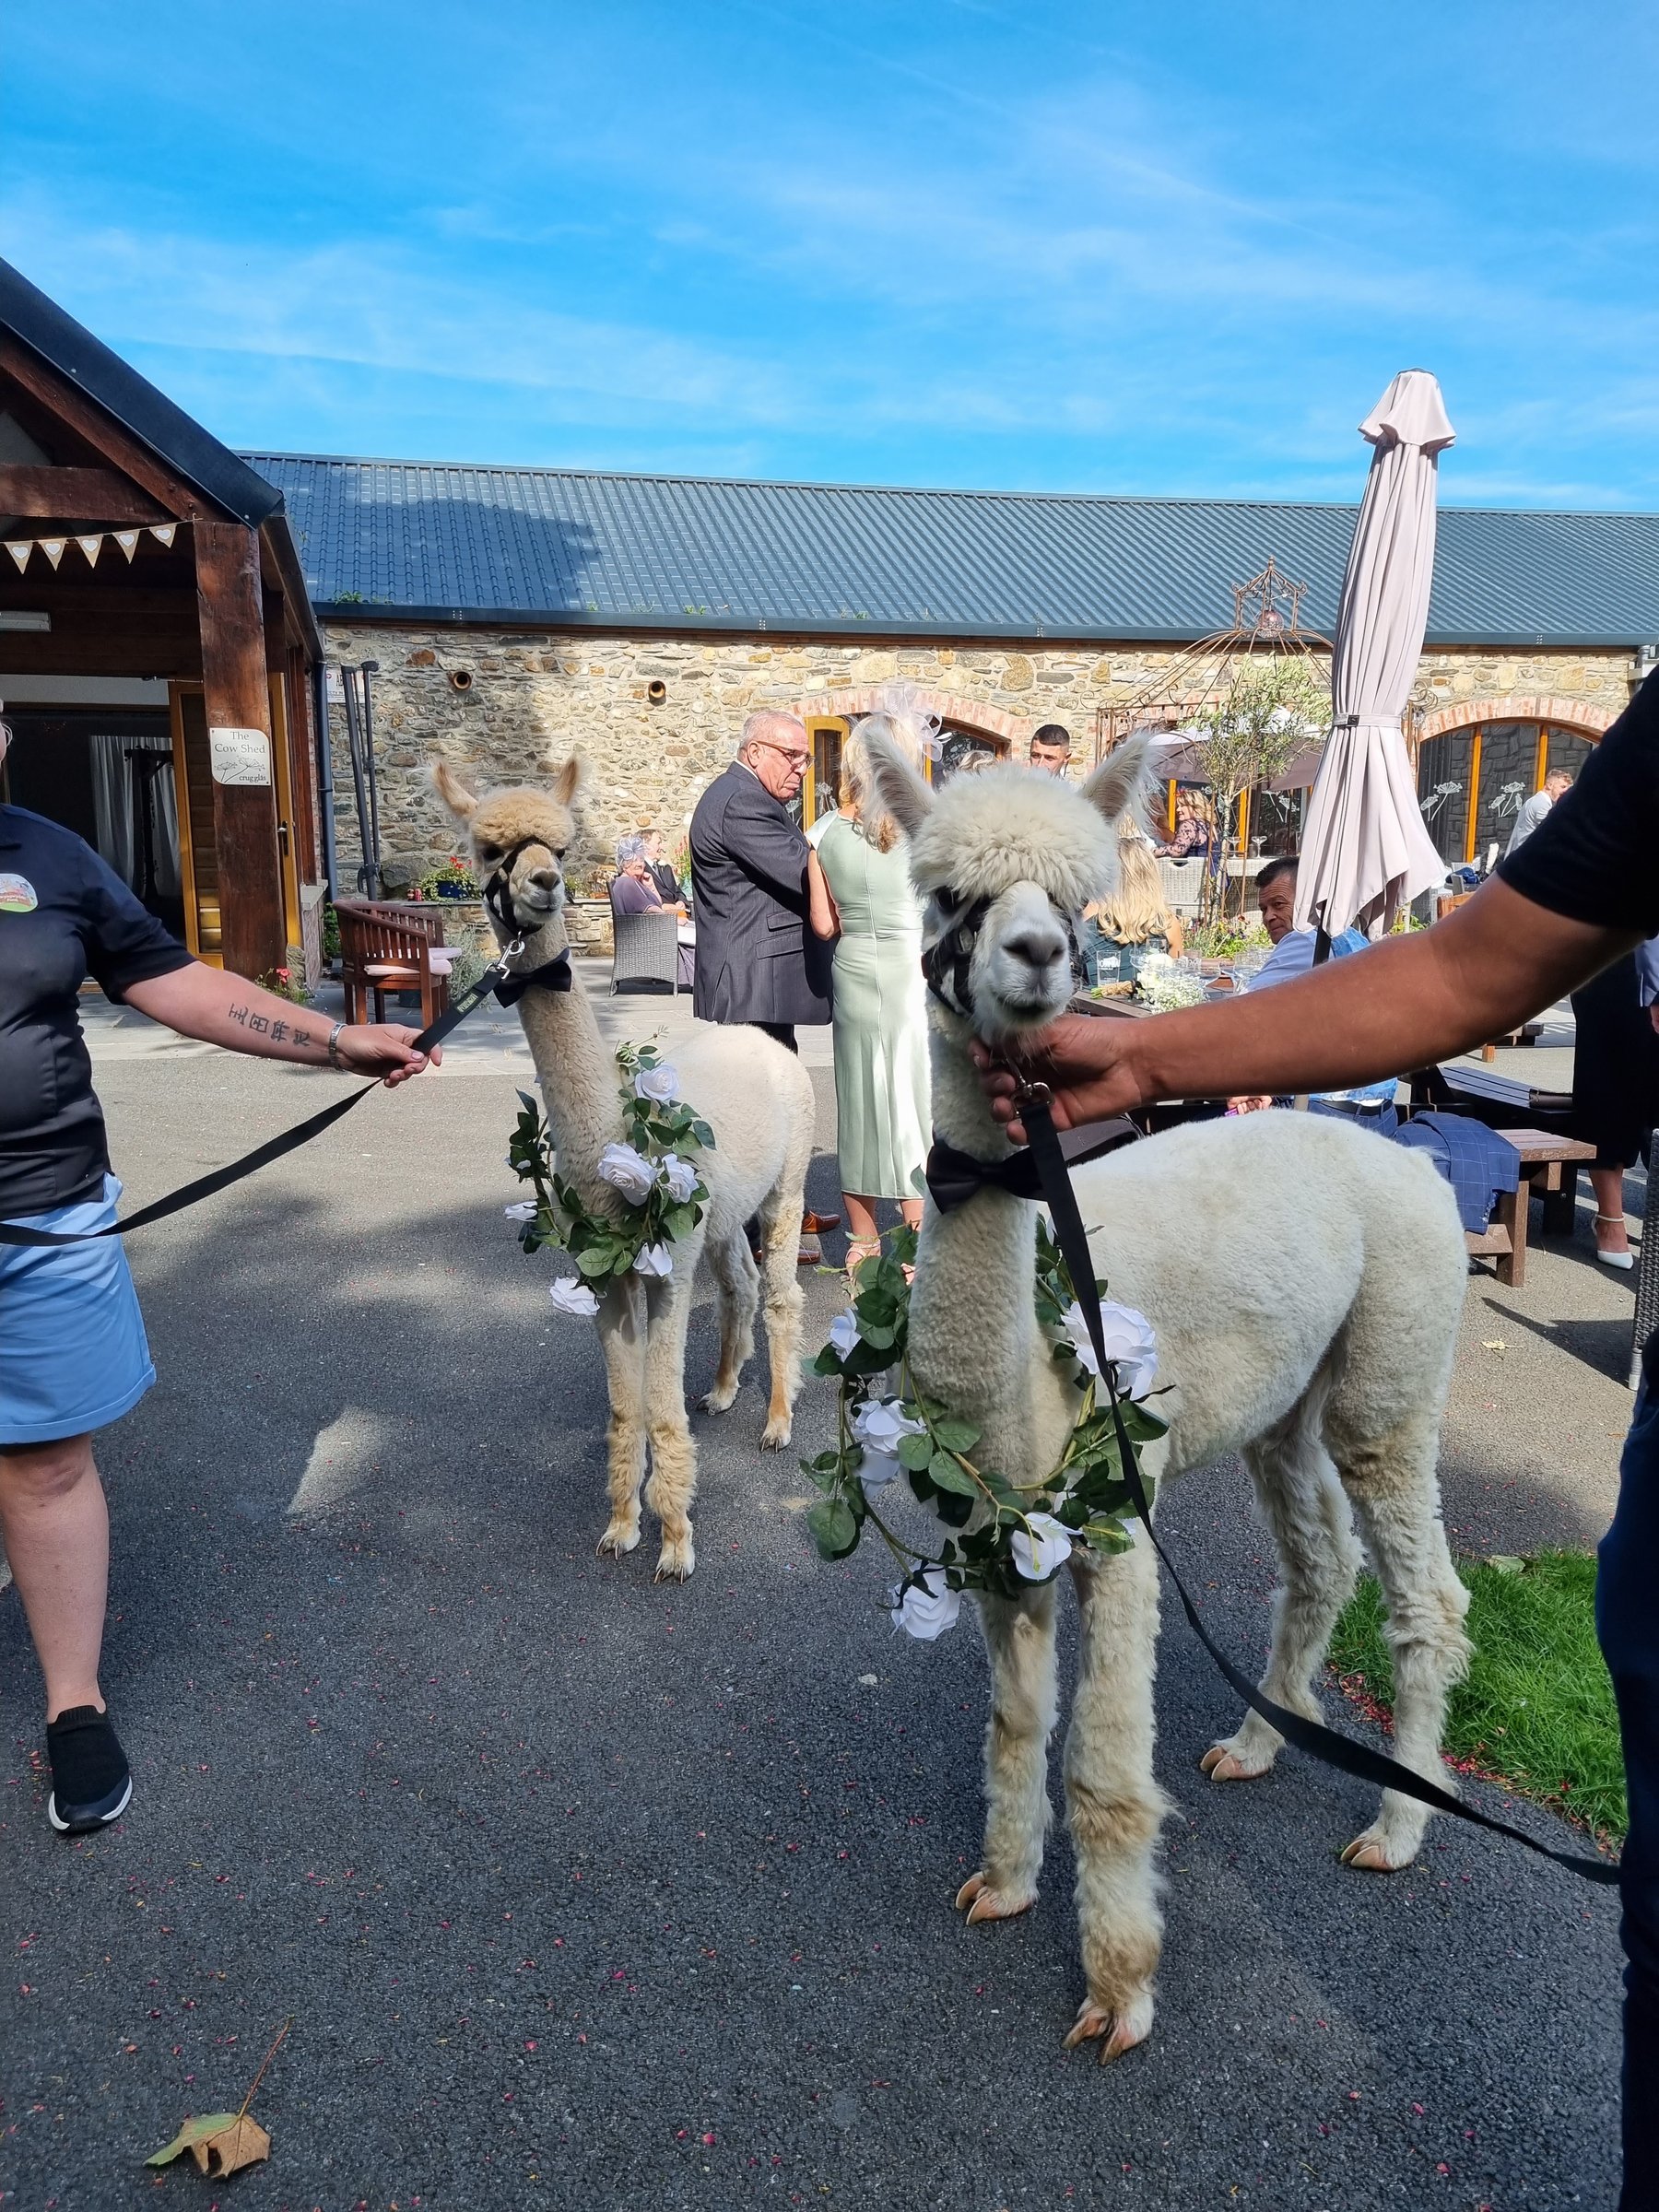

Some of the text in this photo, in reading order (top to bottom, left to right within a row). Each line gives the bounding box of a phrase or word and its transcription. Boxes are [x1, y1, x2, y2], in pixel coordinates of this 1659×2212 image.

[230, 731, 250, 740] The
[215, 743, 265, 753] Cow Shed
